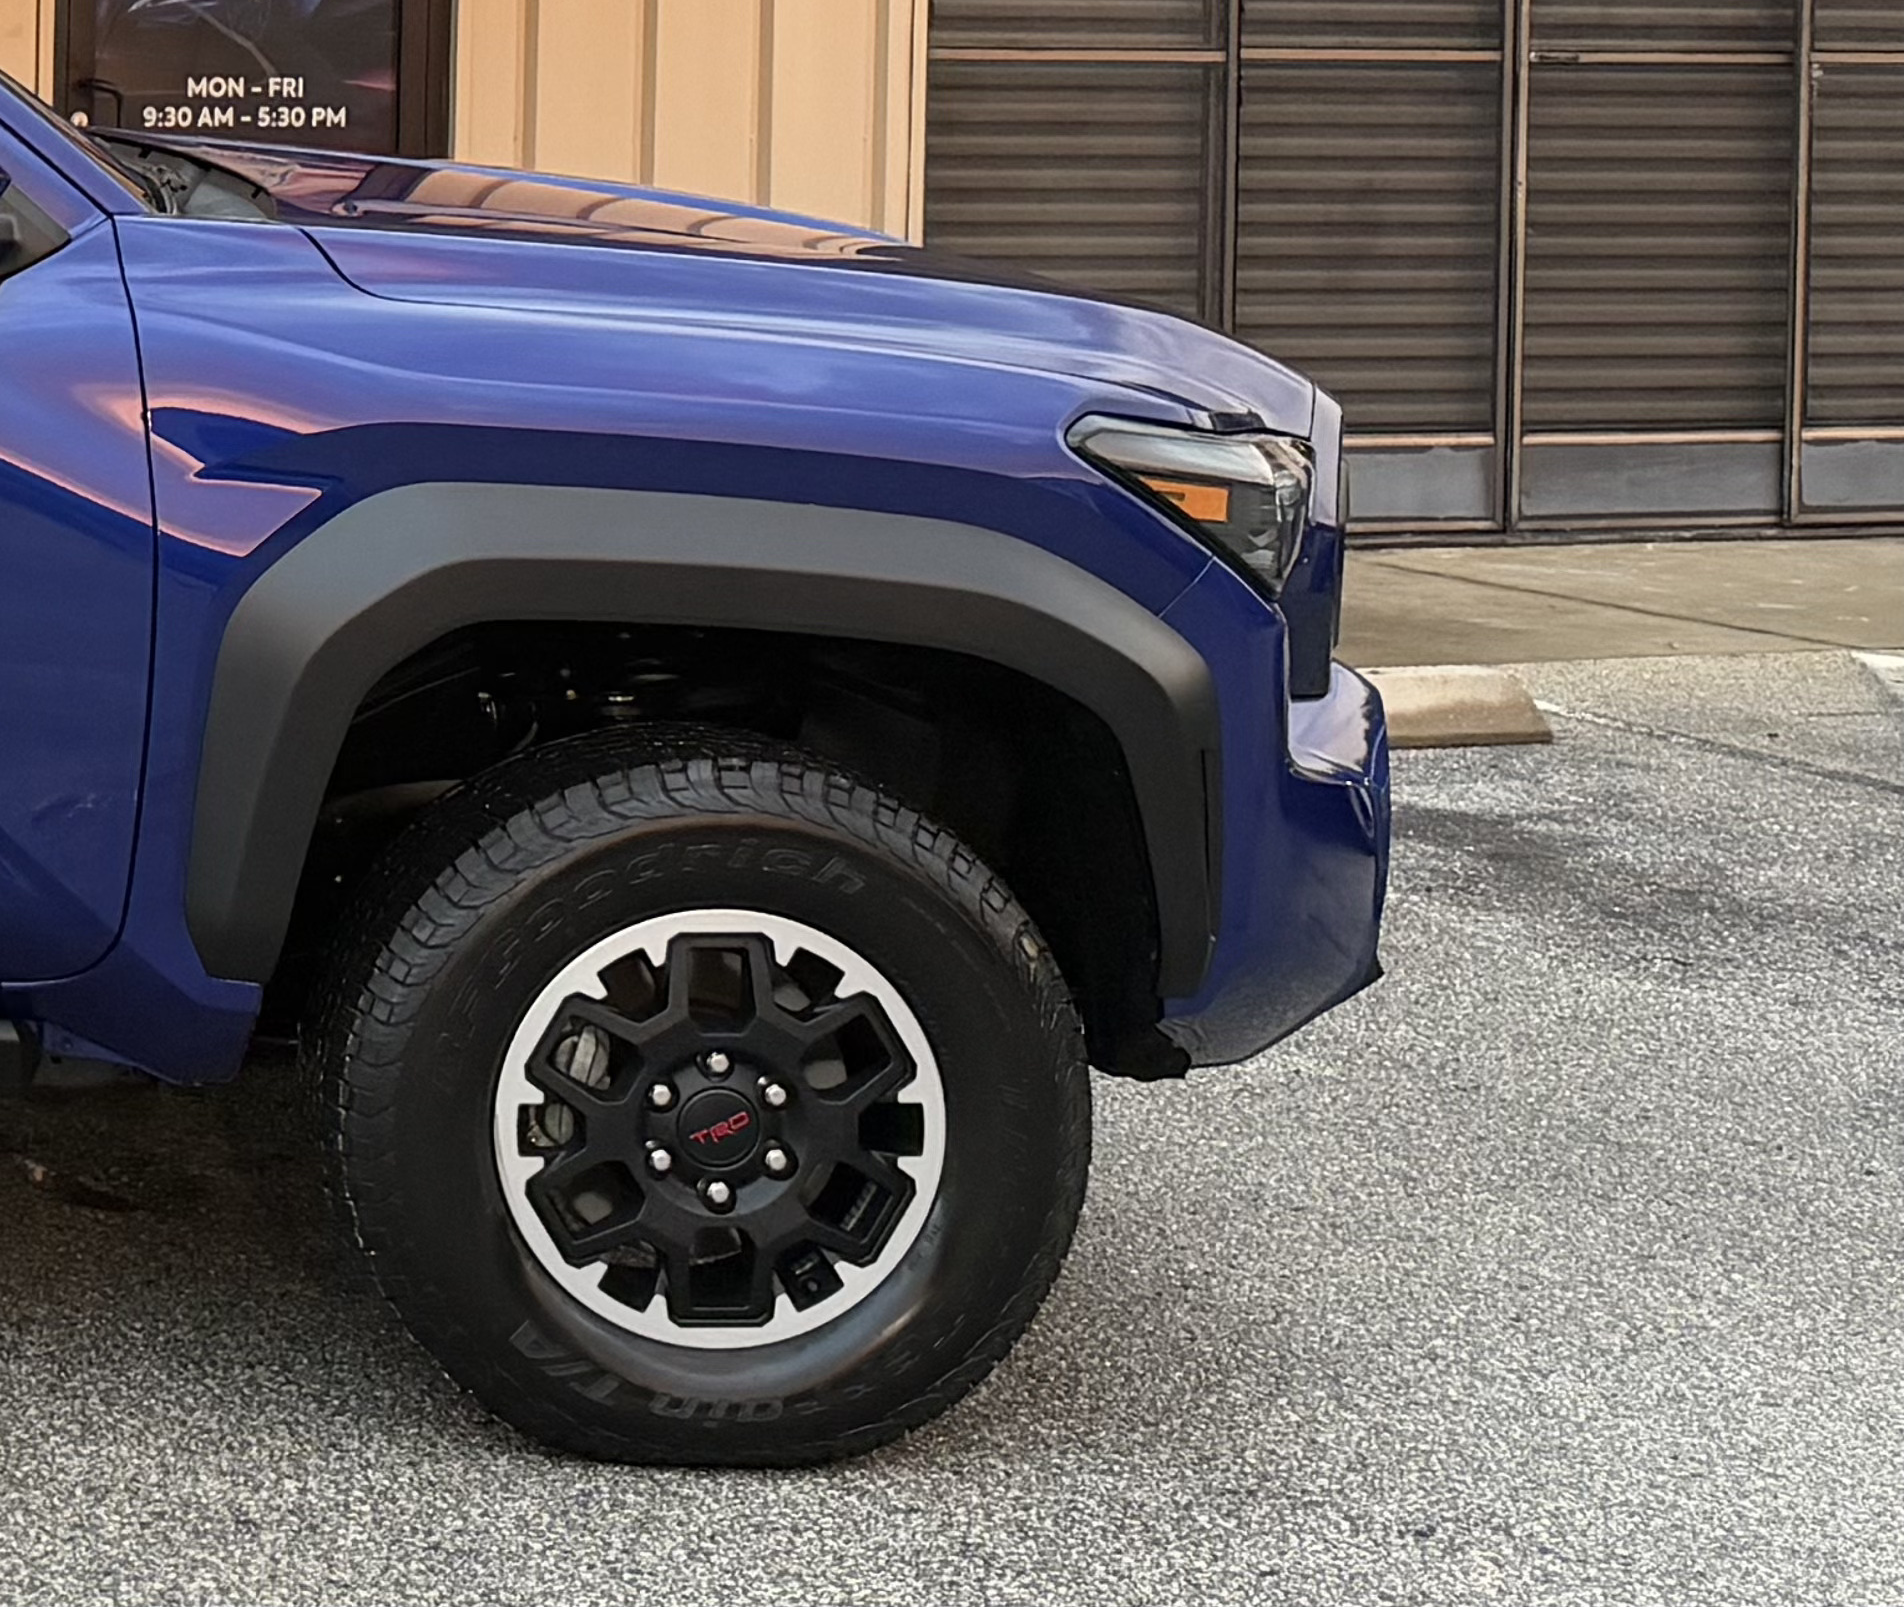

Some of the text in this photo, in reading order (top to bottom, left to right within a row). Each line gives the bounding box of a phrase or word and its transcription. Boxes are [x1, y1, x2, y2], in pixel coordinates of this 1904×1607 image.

[187, 76, 245, 98] MON
[268, 77, 303, 98] FRI
[143, 106, 192, 128] 9:30
[197, 106, 234, 128] AM
[257, 106, 306, 128] 5:30
[311, 106, 346, 128] PM
[688, 1110, 751, 1145] TRD
